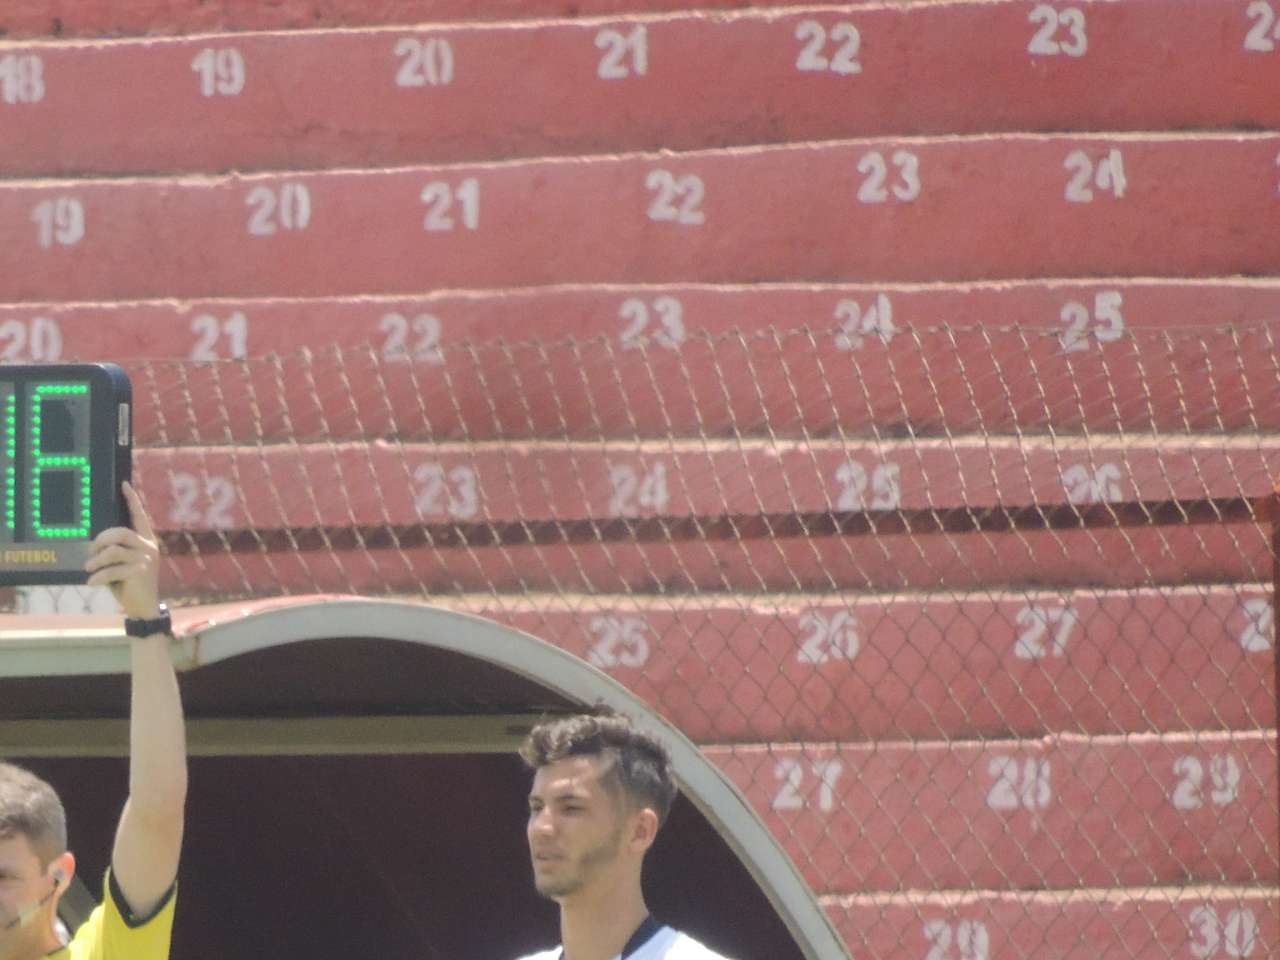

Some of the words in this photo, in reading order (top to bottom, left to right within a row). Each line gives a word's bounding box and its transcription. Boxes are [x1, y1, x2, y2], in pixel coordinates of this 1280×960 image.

[595, 25, 649, 80] 21
[796, 20, 862, 74] 22
[1027, 6, 1087, 57] 23
[1244, 1, 1280, 52] 2
[191, 48, 245, 96] 19
[395, 38, 454, 87] 20
[646, 170, 706, 226] 22
[857, 151, 920, 202] 23
[1064, 148, 1126, 202] 24
[32, 197, 85, 248] 19
[246, 183, 311, 236] 20
[420, 178, 480, 231] 21
[191, 311, 248, 361] 21
[379, 313, 442, 362] 22
[619, 296, 684, 352] 23
[834, 293, 894, 350] 24
[1060, 291, 1124, 354] 25
[6, 384, 91, 538] 16
[835, 462, 901, 511] 25
[171, 473, 235, 528] 22
[415, 464, 477, 520] 23
[610, 464, 669, 516] 24
[4, 549, 58, 563] FUTEBOL
[590, 618, 650, 668] 25
[797, 611, 860, 664] 26
[1014, 606, 1078, 658] 27
[1240, 598, 1274, 652] 2
[772, 758, 843, 812] 27
[986, 755, 1052, 809] 28
[1171, 754, 1241, 810] 29
[1189, 906, 1255, 958] 30
